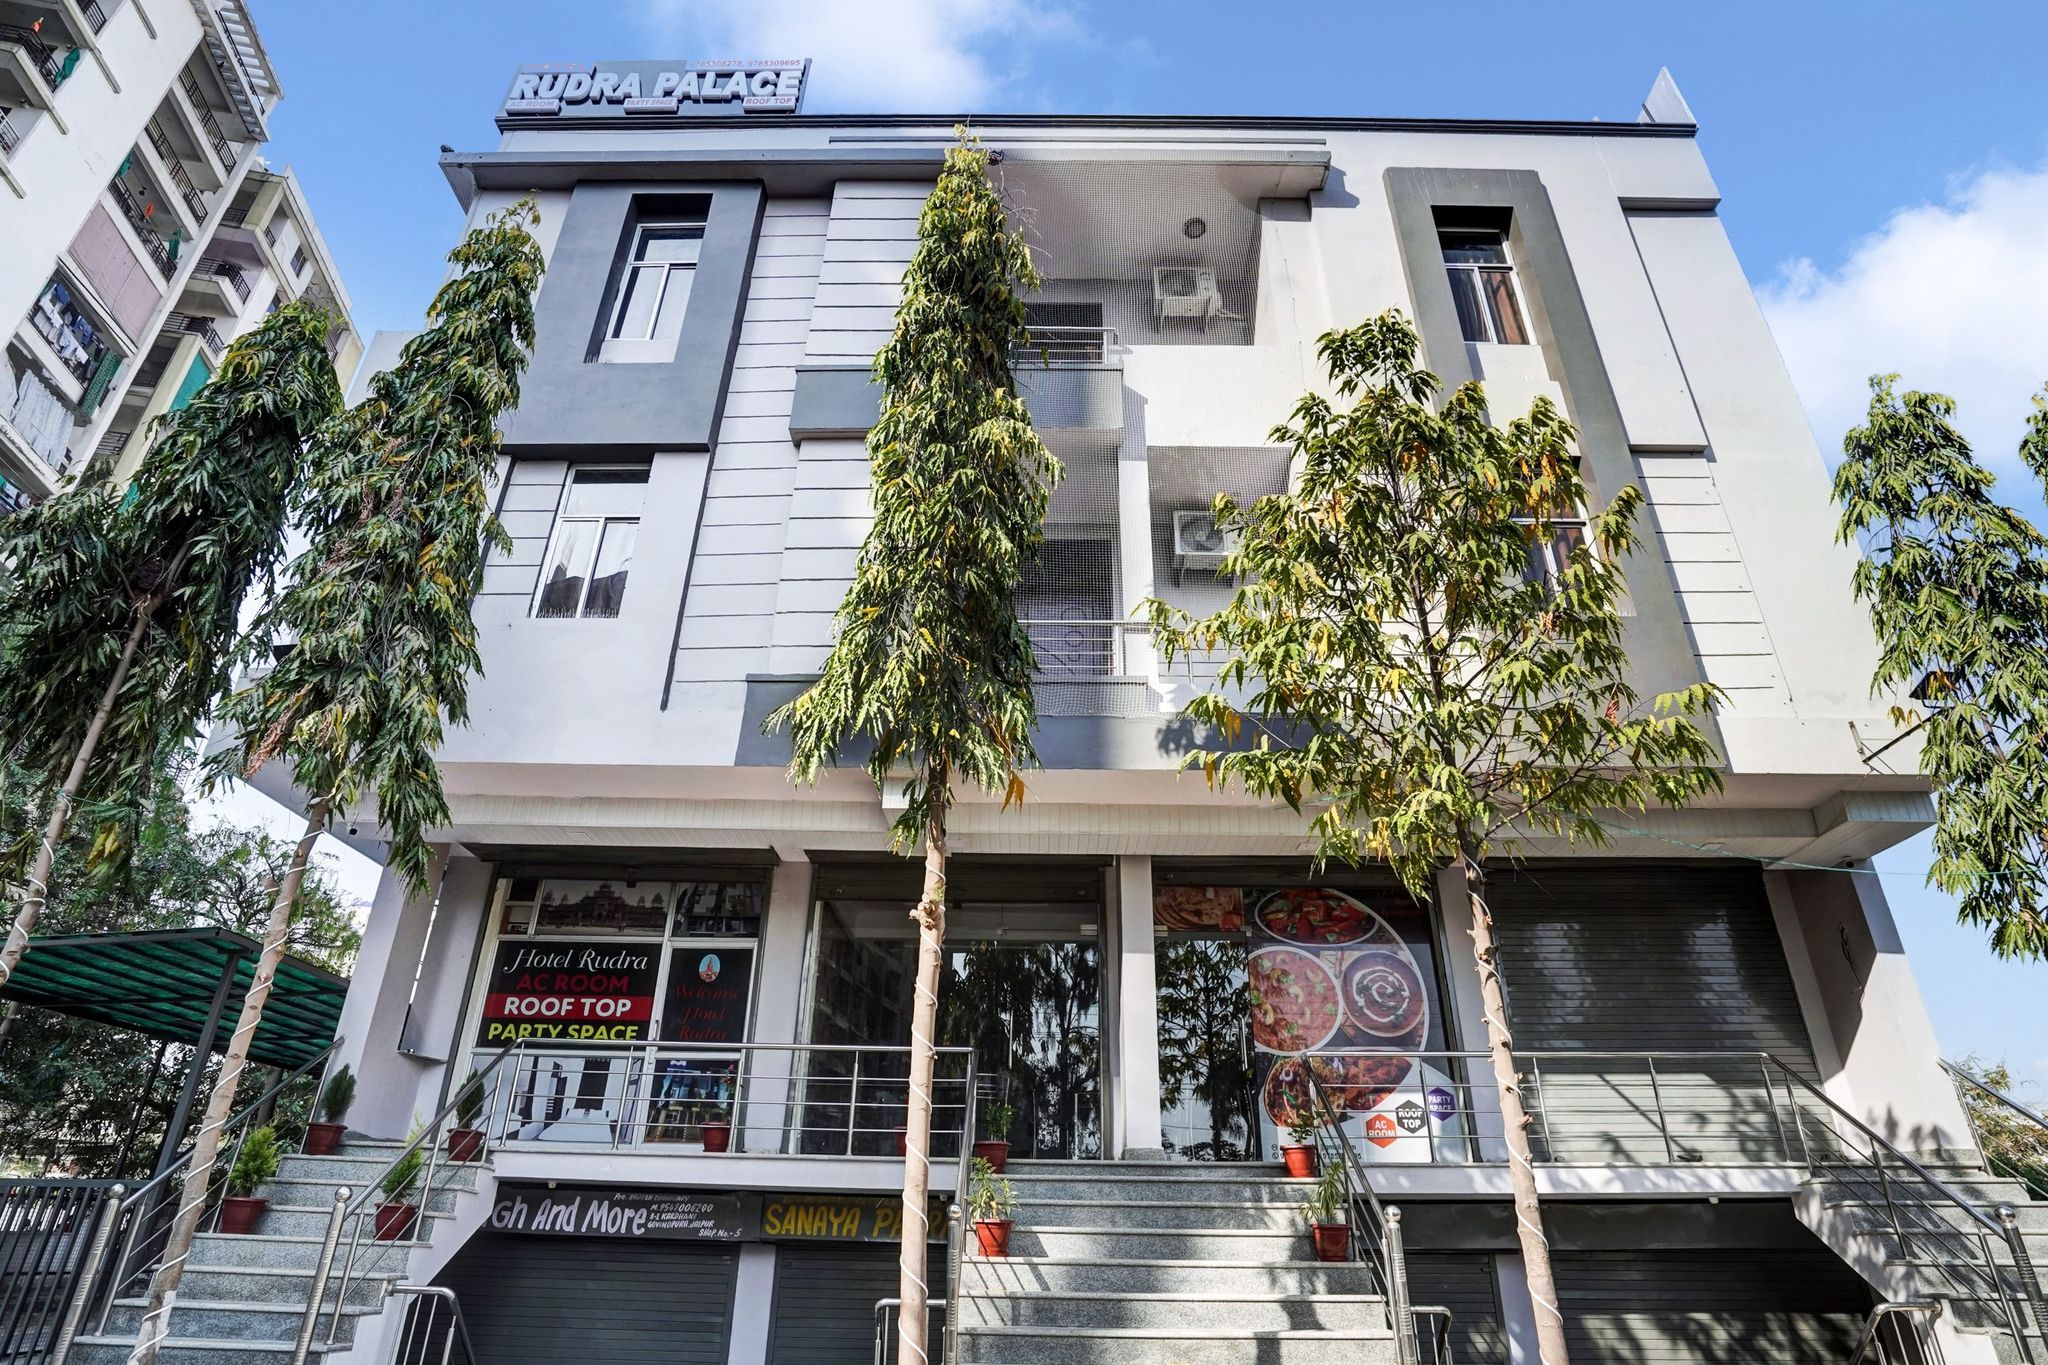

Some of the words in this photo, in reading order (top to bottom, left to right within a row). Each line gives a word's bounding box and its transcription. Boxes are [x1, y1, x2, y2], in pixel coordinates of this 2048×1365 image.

[509, 72, 643, 102] RUDRA
[652, 70, 803, 99] PALACE
[626, 98, 650, 106] PARTY
[651, 97, 675, 106] SPACE
[745, 97, 771, 105] ROOF
[773, 97, 793, 105] TOP
[503, 948, 574, 974] Hotel
[578, 947, 649, 972] Rudra
[516, 973, 550, 992] AC
[554, 974, 630, 993] ROOM
[504, 996, 576, 1016] ROOF
[580, 998, 632, 1017] TOP
[487, 1022, 563, 1040] PARTY
[565, 1024, 639, 1041] SPACE
[678, 1026, 727, 1041] Rudra
[1427, 1095, 1451, 1104] PARTY
[1398, 1108, 1424, 1118] ROOF
[1374, 1120, 1388, 1129] AC
[1402, 1119, 1422, 1129] TOP
[531, 1195, 581, 1233] And
[581, 1200, 648, 1235] More
[764, 1203, 861, 1238] SANAYA
